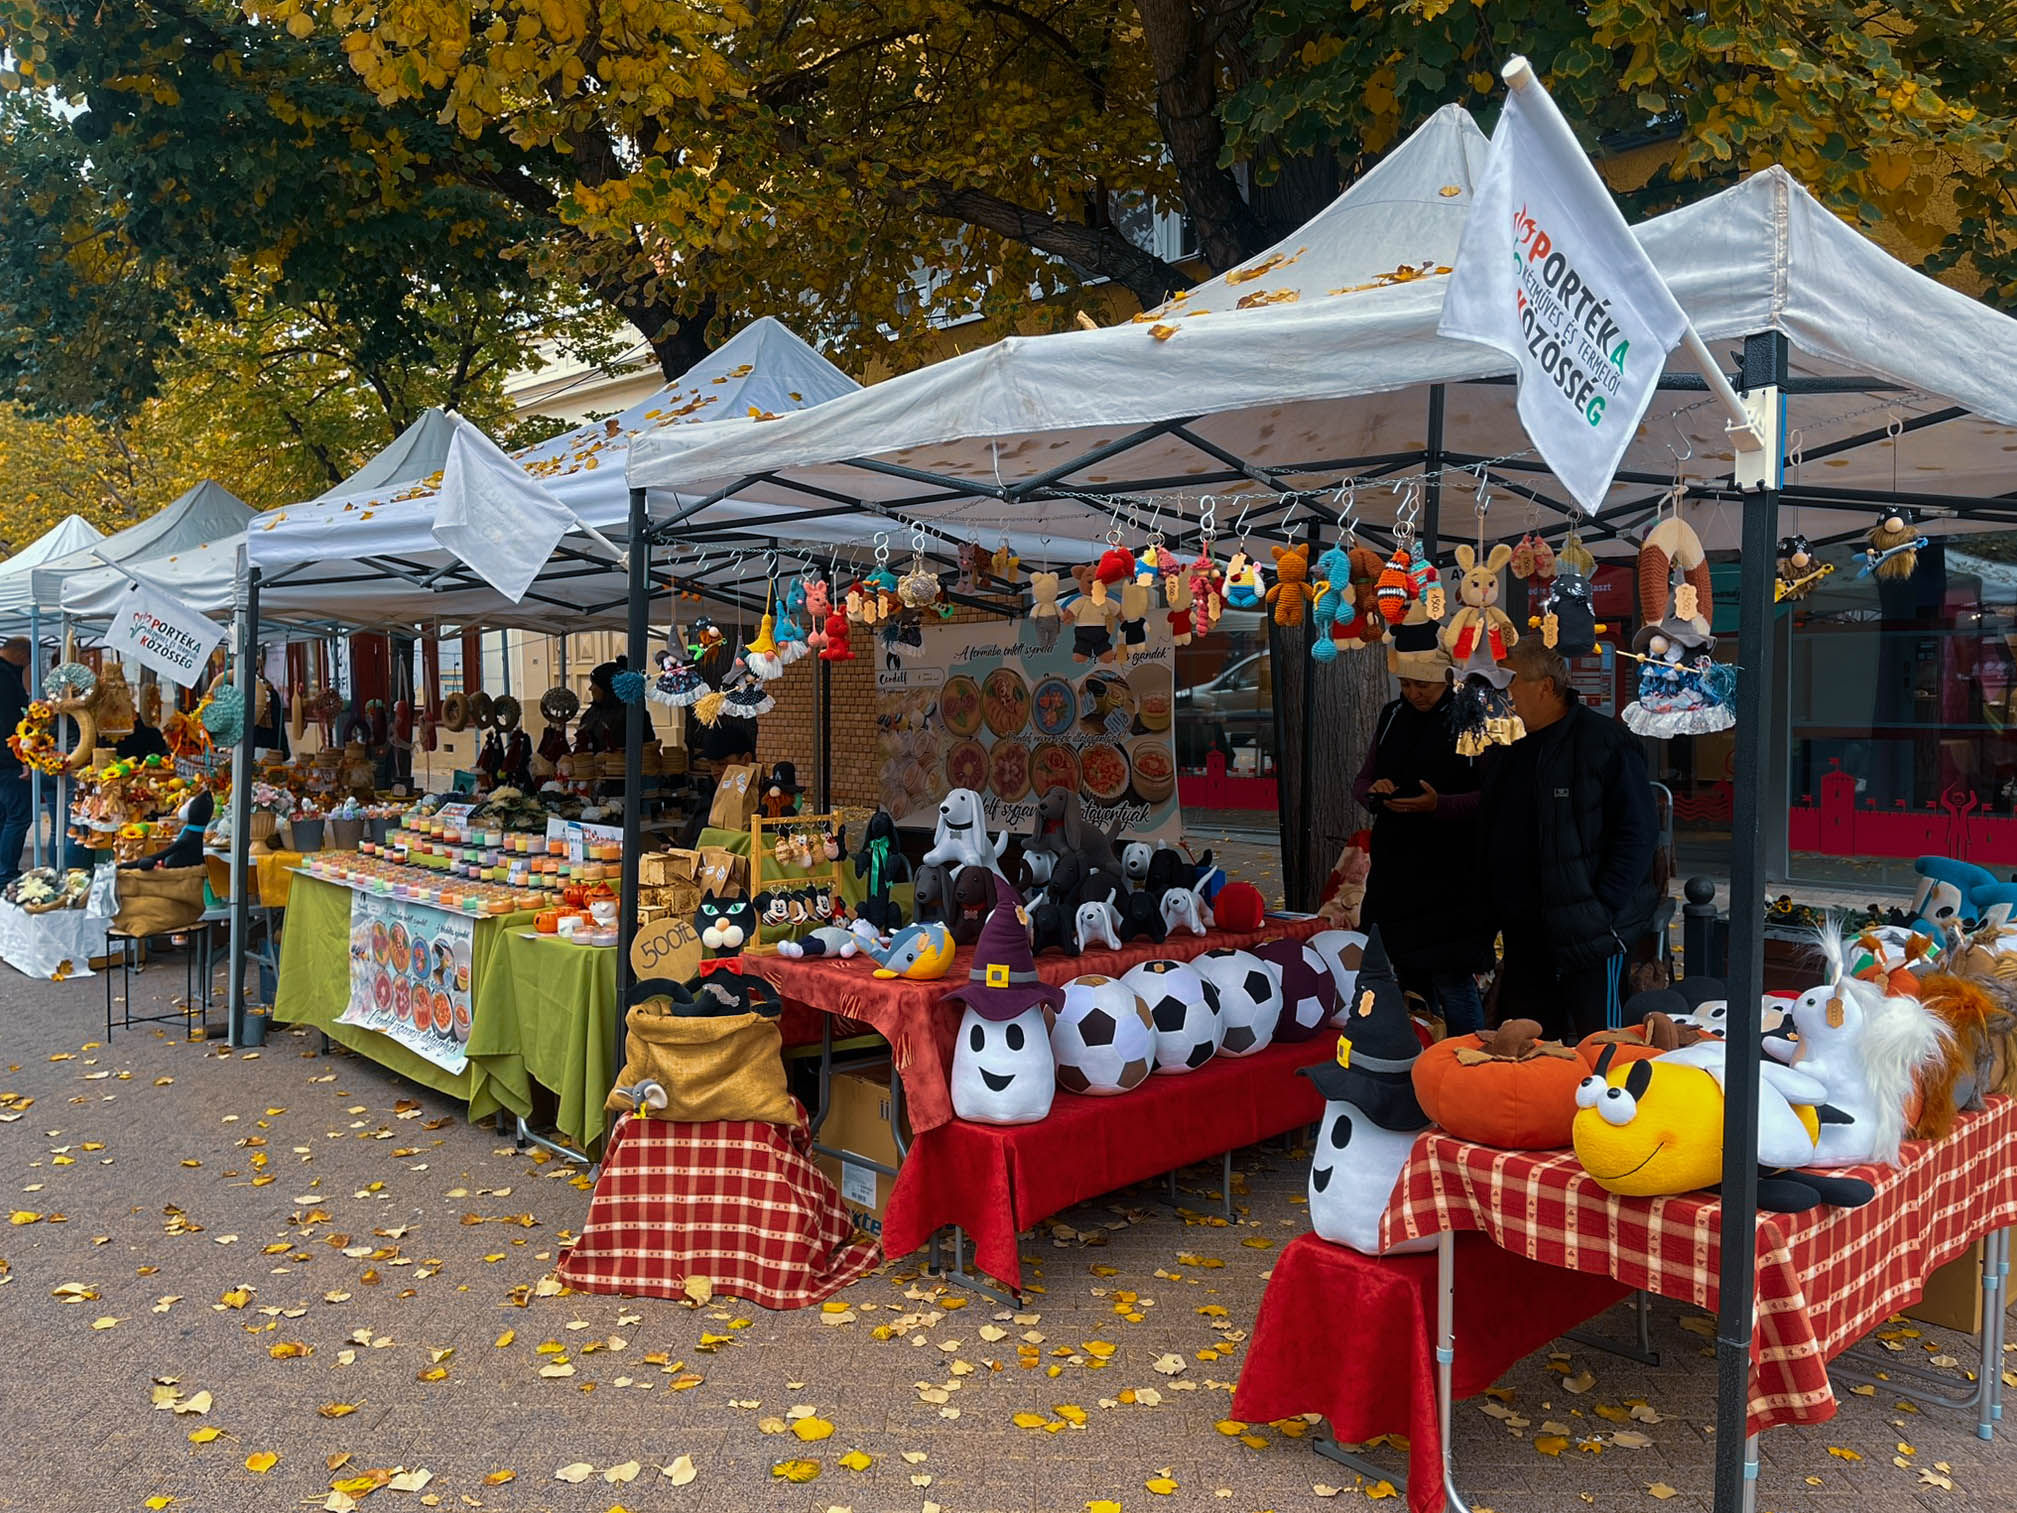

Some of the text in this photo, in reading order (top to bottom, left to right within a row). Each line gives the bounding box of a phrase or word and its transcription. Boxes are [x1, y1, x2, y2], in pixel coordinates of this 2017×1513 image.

[1529, 231, 1630, 376] PORTÉKA
[1563, 319, 1579, 345] ÉS
[140, 635, 193, 670] KÖZÖSSÉG
[151, 618, 202, 655] PORTÉKA
